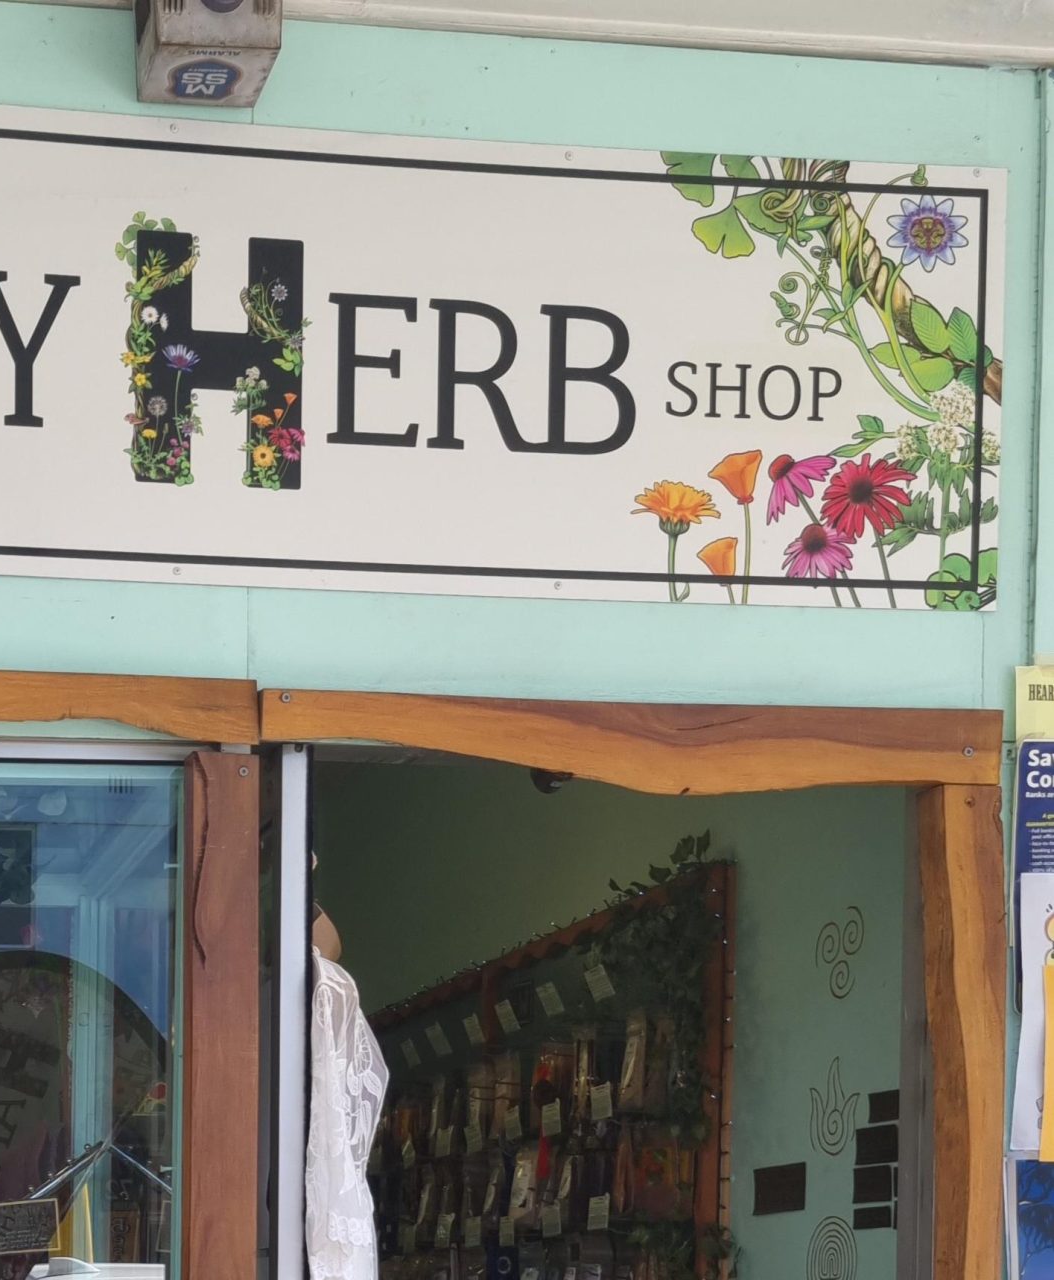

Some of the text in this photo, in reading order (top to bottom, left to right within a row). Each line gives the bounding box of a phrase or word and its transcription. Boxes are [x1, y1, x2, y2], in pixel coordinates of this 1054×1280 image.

[118, 213, 638, 490] HERB
[666, 361, 844, 424] SHOP
[1027, 749, 1054, 767] Sa
[1026, 770, 1054, 788] Co
